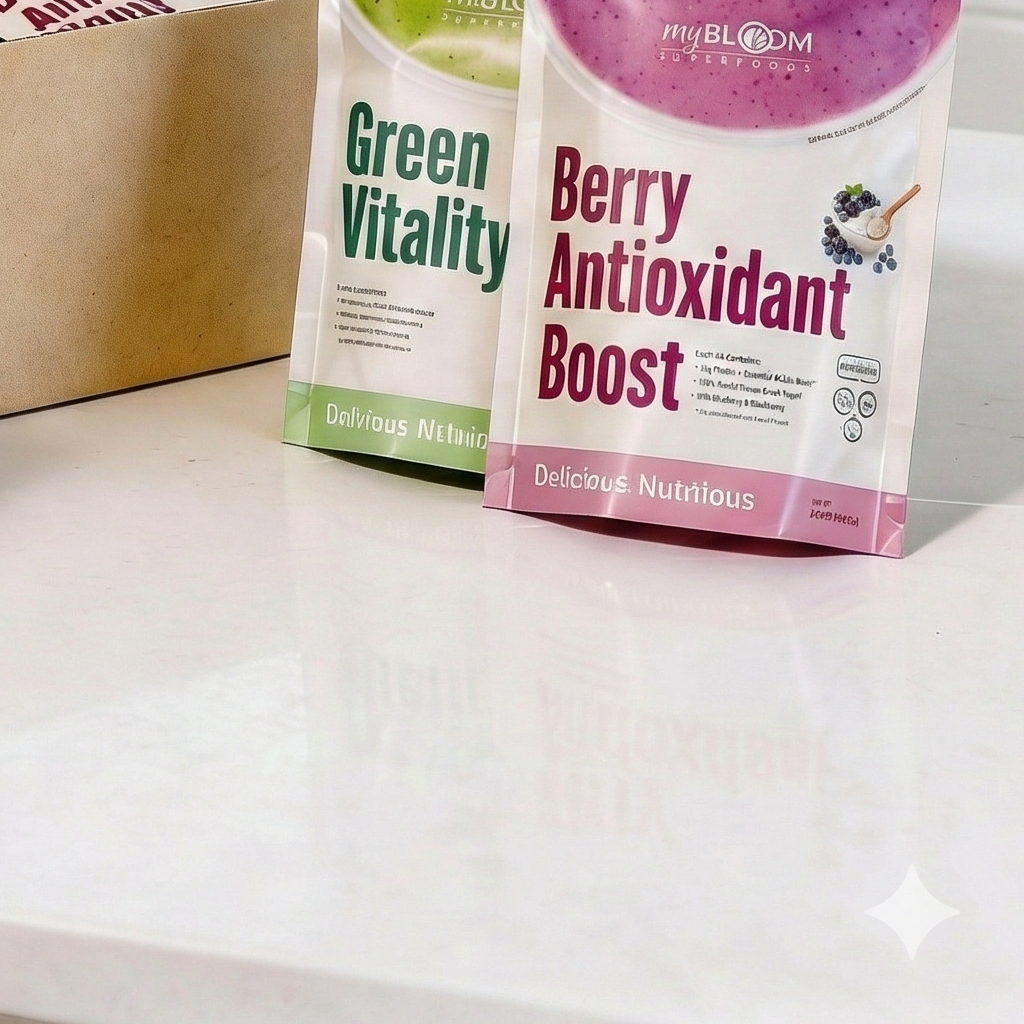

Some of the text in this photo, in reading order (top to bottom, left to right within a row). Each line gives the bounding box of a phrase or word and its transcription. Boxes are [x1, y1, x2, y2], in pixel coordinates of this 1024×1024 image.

[346, 101, 491, 191] Green
[549, 145, 692, 244] Berry
[342, 182, 511, 293] Vitality
[543, 231, 851, 340] Antioxidant
[538, 323, 685, 412] Boost
